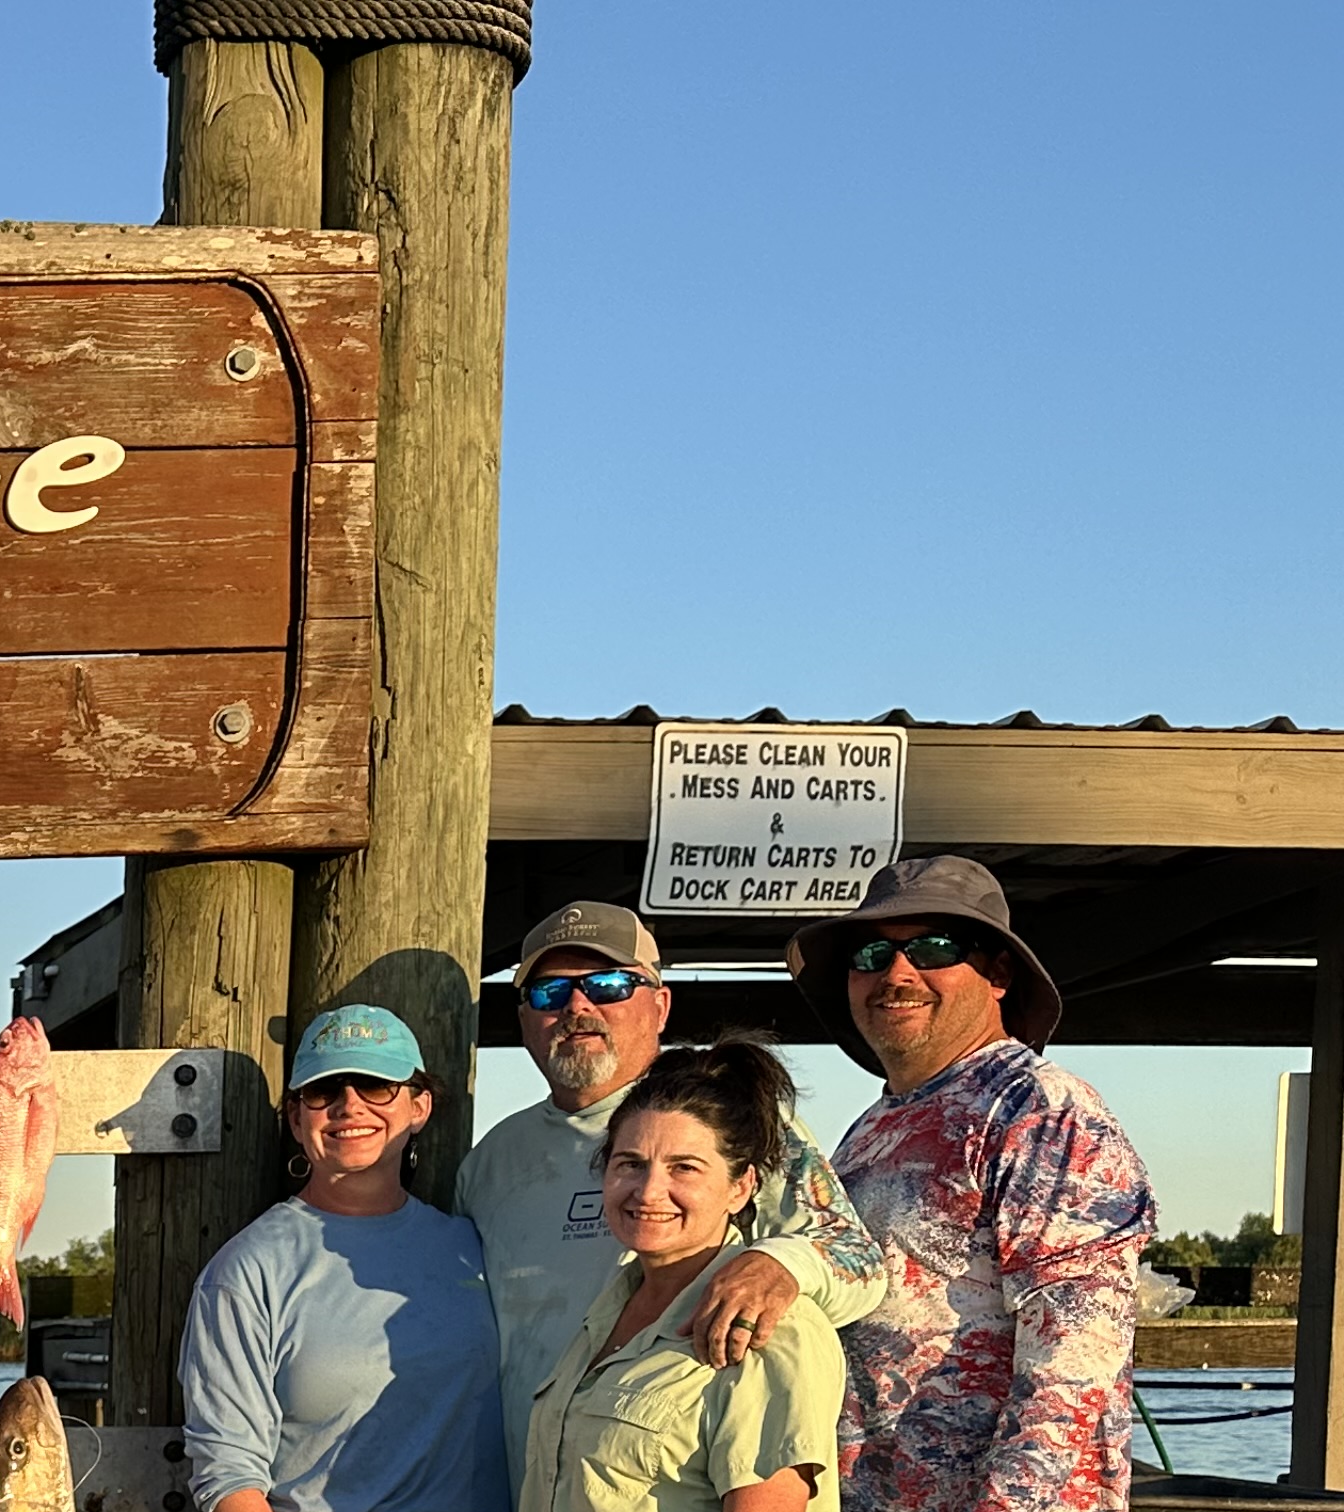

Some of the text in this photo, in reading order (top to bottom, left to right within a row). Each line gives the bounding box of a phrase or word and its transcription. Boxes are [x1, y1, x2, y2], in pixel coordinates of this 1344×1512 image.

[669, 740, 892, 767] PLEASE CLEAN YOUR
[682, 775, 739, 799] MESS
[750, 776, 795, 800] AND
[770, 812, 784, 835] &
[670, 842, 876, 868] RETURN CARTS TO
[669, 876, 861, 901] DOCK CART AREA
[562, 1222, 595, 1232] OCEAN
